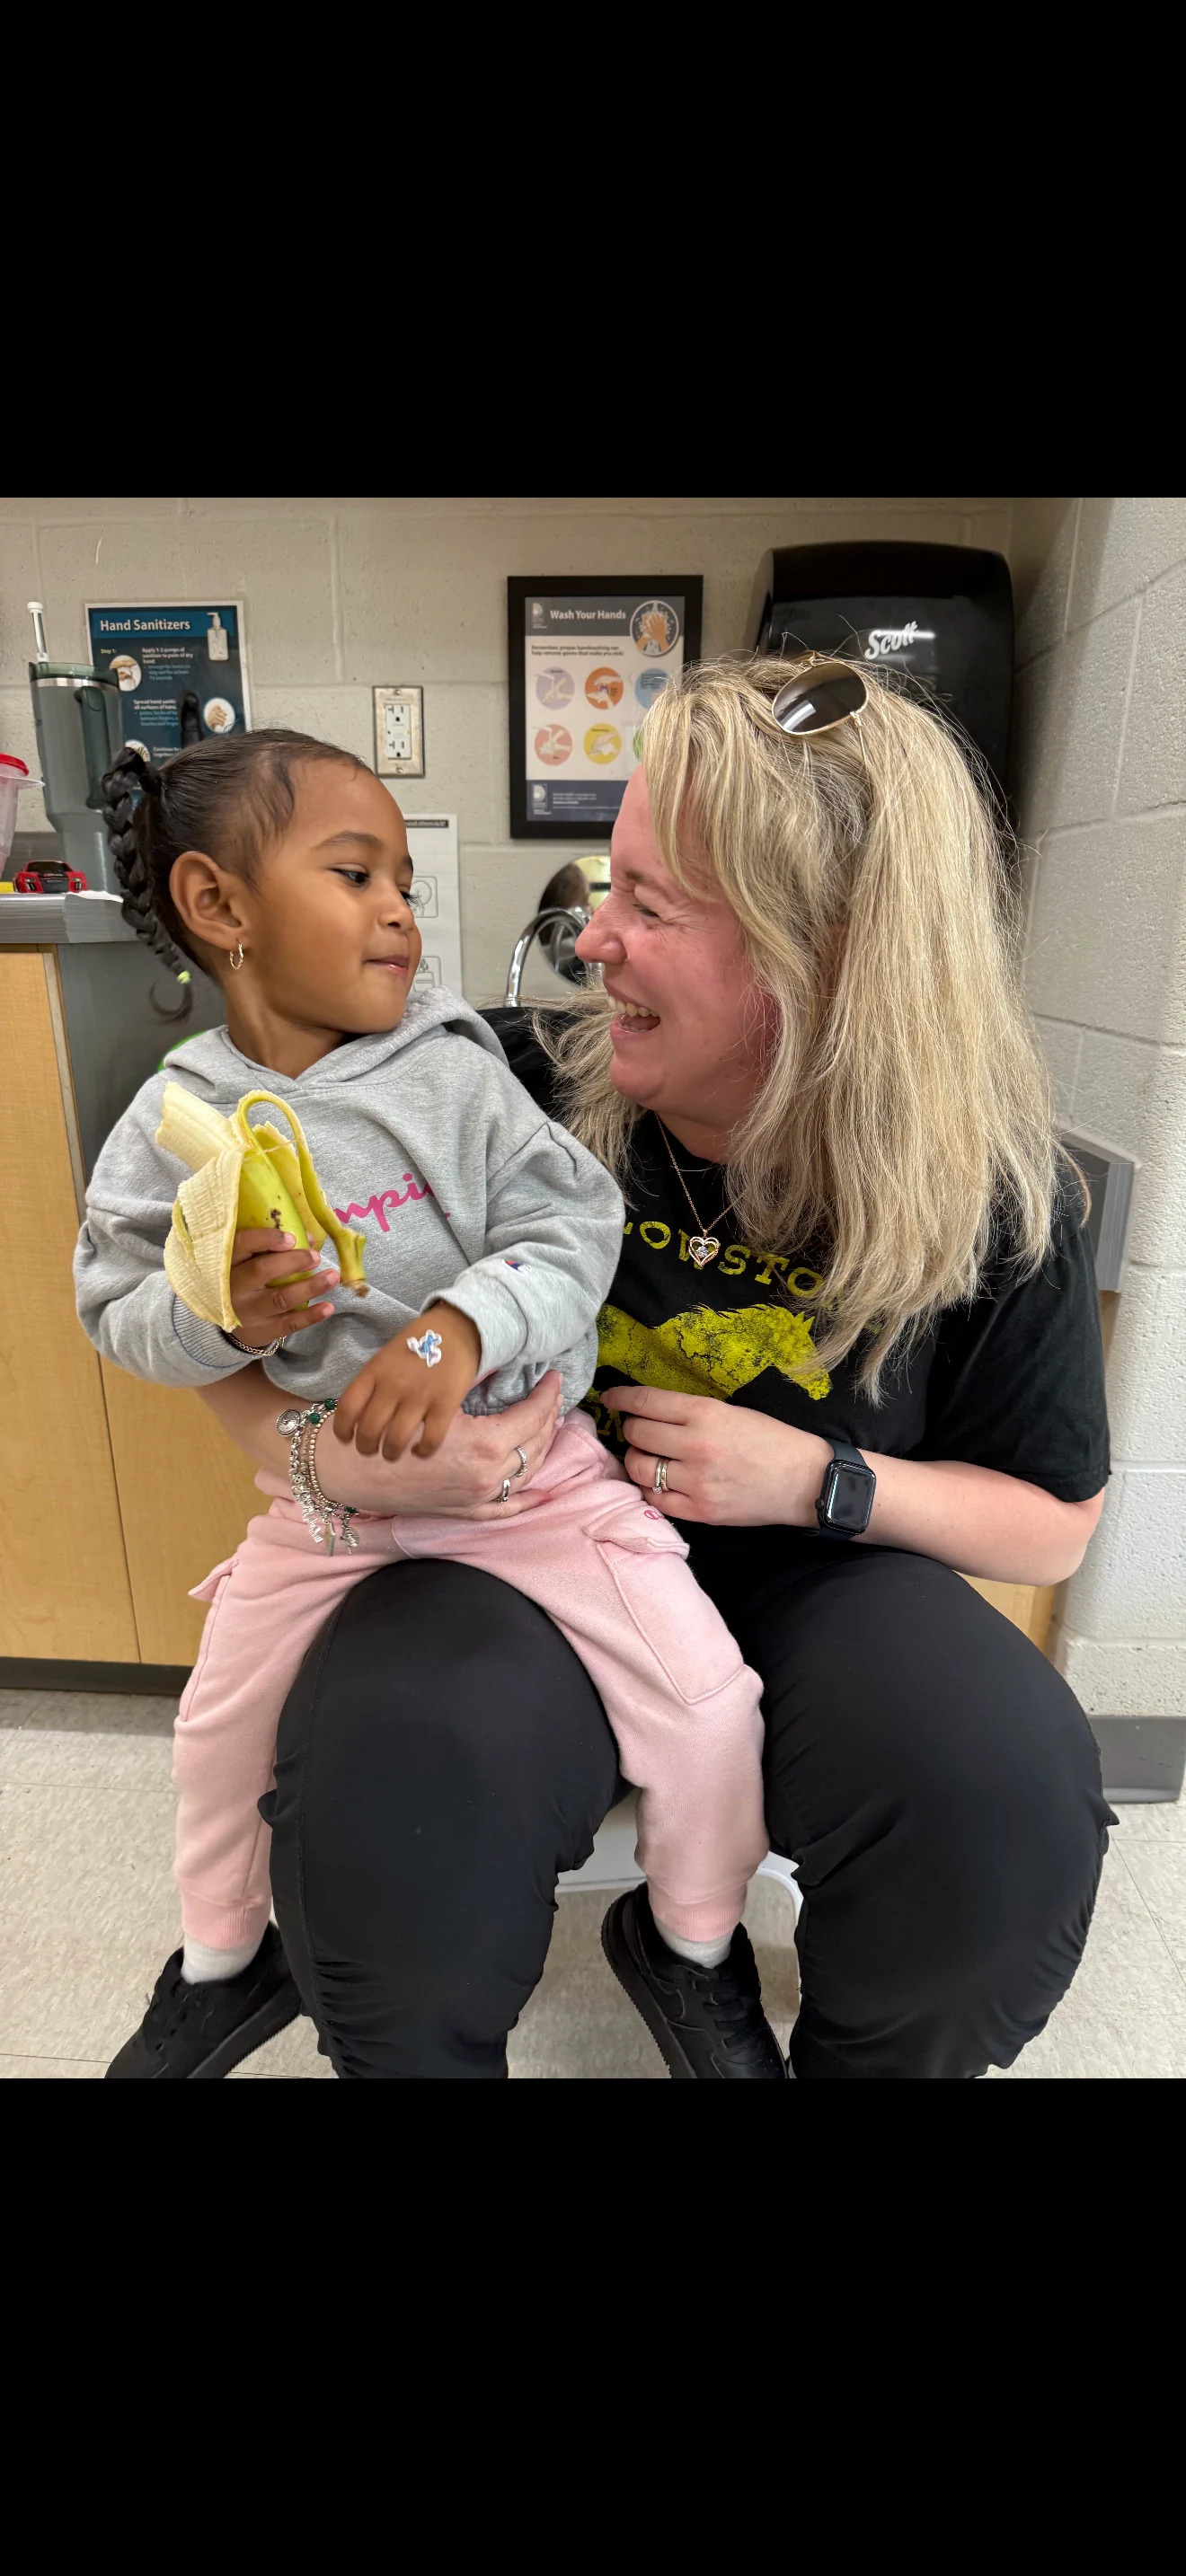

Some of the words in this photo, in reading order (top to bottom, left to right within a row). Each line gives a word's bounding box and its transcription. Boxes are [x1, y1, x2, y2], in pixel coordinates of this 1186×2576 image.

[550, 610, 574, 620] Wash
[575, 610, 597, 620] Your
[597, 610, 626, 620] Hands
[100, 620, 131, 631] Hand
[134, 619, 191, 631] Sanitizers
[864, 621, 918, 660] Scott
